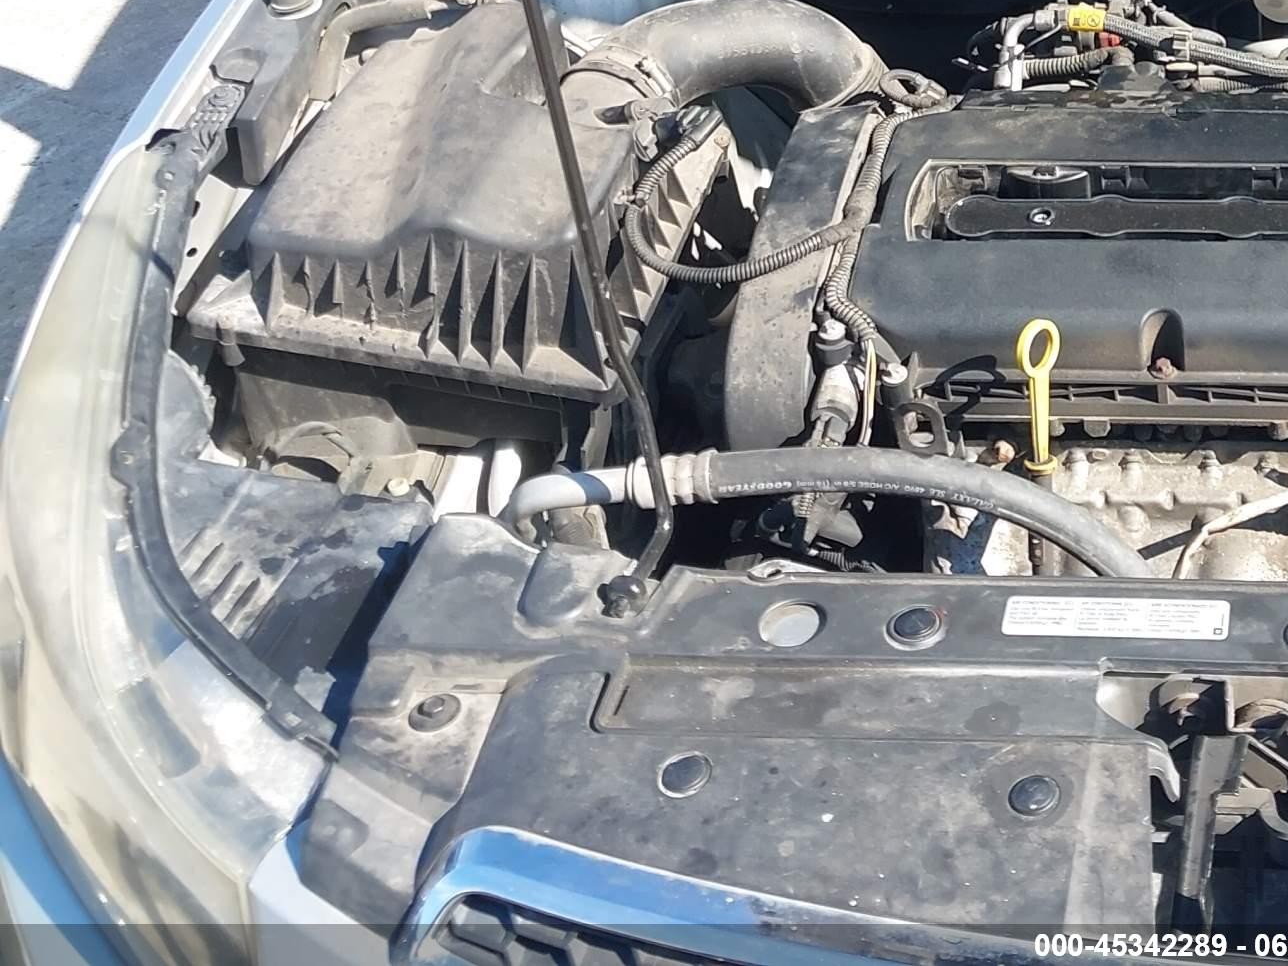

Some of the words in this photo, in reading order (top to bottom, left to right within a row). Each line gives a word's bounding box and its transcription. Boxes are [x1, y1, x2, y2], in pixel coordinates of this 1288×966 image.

[717, 480, 792, 494] GOODYEAR
[858, 480, 883, 490] HOSE
[884, 481, 900, 490] A/C
[950, 491, 995, 509] GALAXY
